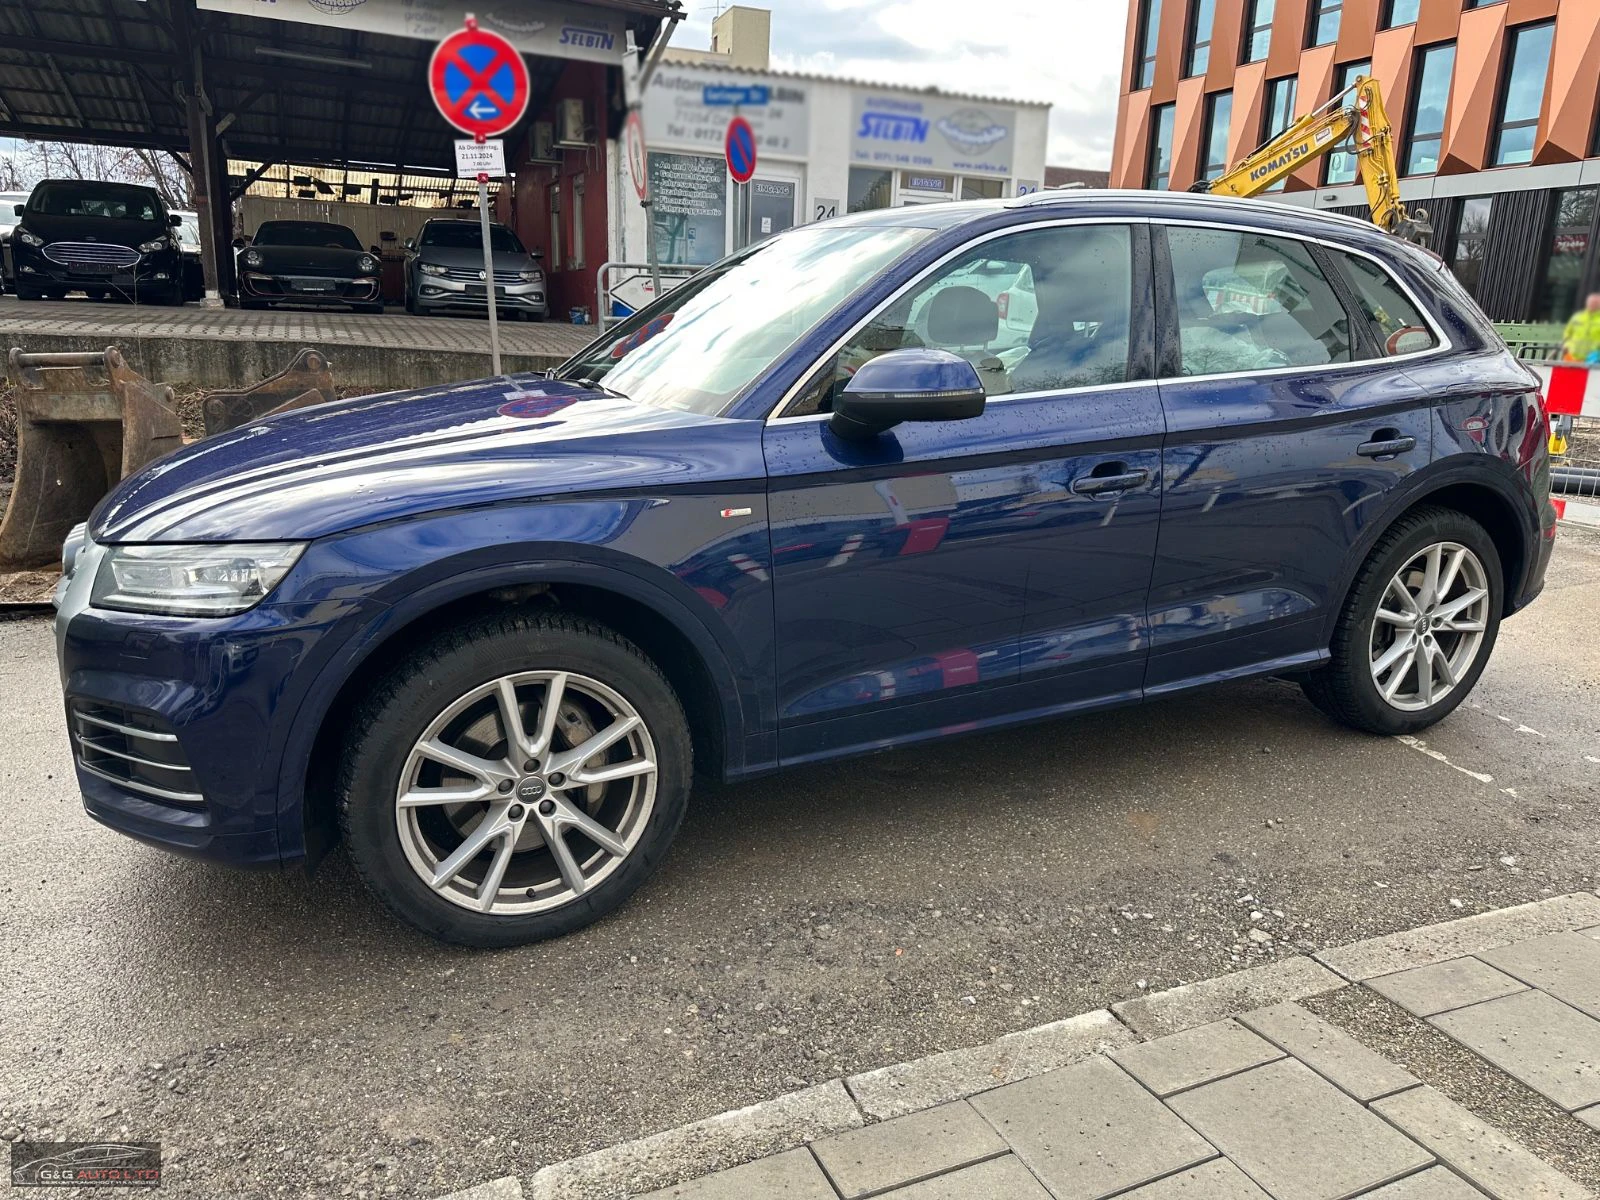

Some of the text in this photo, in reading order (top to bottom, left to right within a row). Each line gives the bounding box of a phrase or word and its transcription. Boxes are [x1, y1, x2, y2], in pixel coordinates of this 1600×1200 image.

[559, 27, 615, 50] SELBIN
[1250, 143, 1309, 181] KOMATSU
[756, 183, 789, 194] EINGANG
